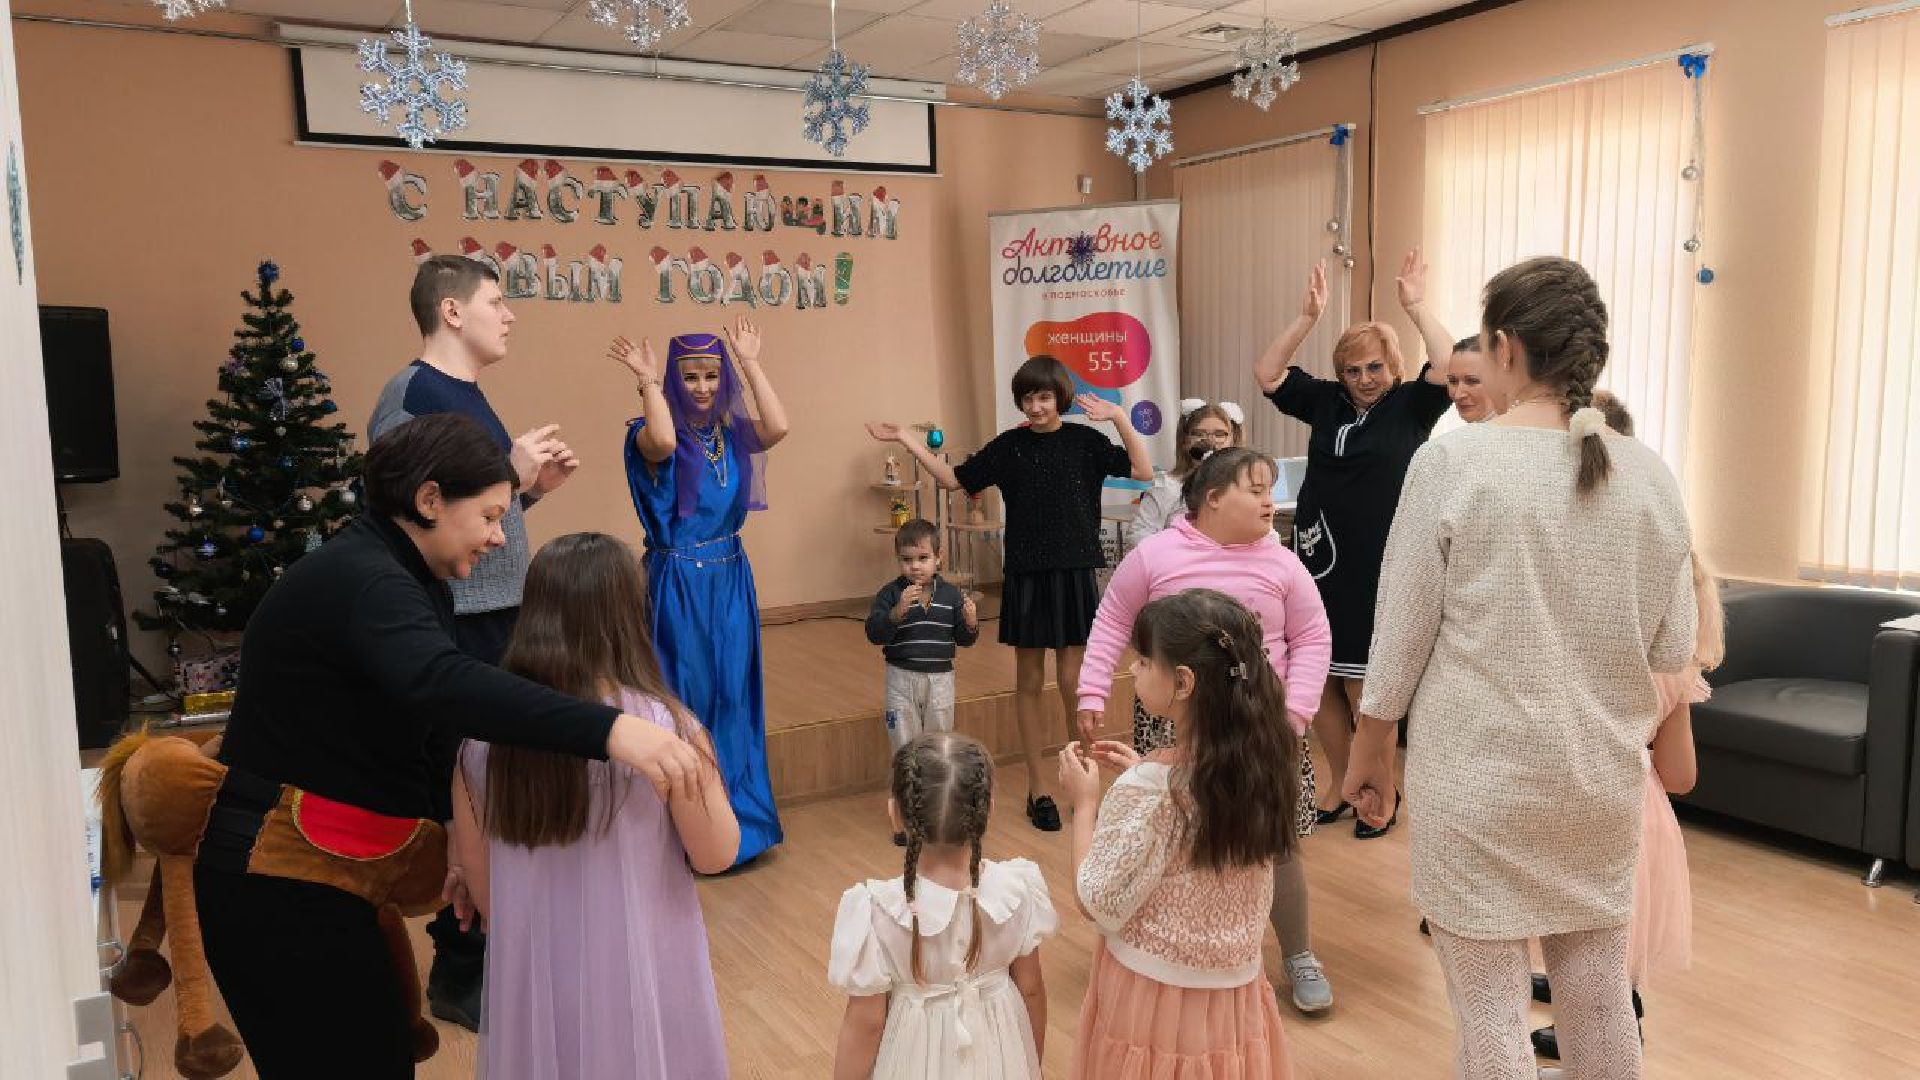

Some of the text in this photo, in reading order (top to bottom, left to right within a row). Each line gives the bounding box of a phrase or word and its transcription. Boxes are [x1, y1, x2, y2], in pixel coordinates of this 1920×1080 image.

[379, 159, 428, 221] С
[1002, 223, 1161, 259] Актвное
[649, 246, 854, 309] ГОДОМ!
[1047, 331, 1128, 346] женщины
[1089, 351, 1128, 371] 55+
